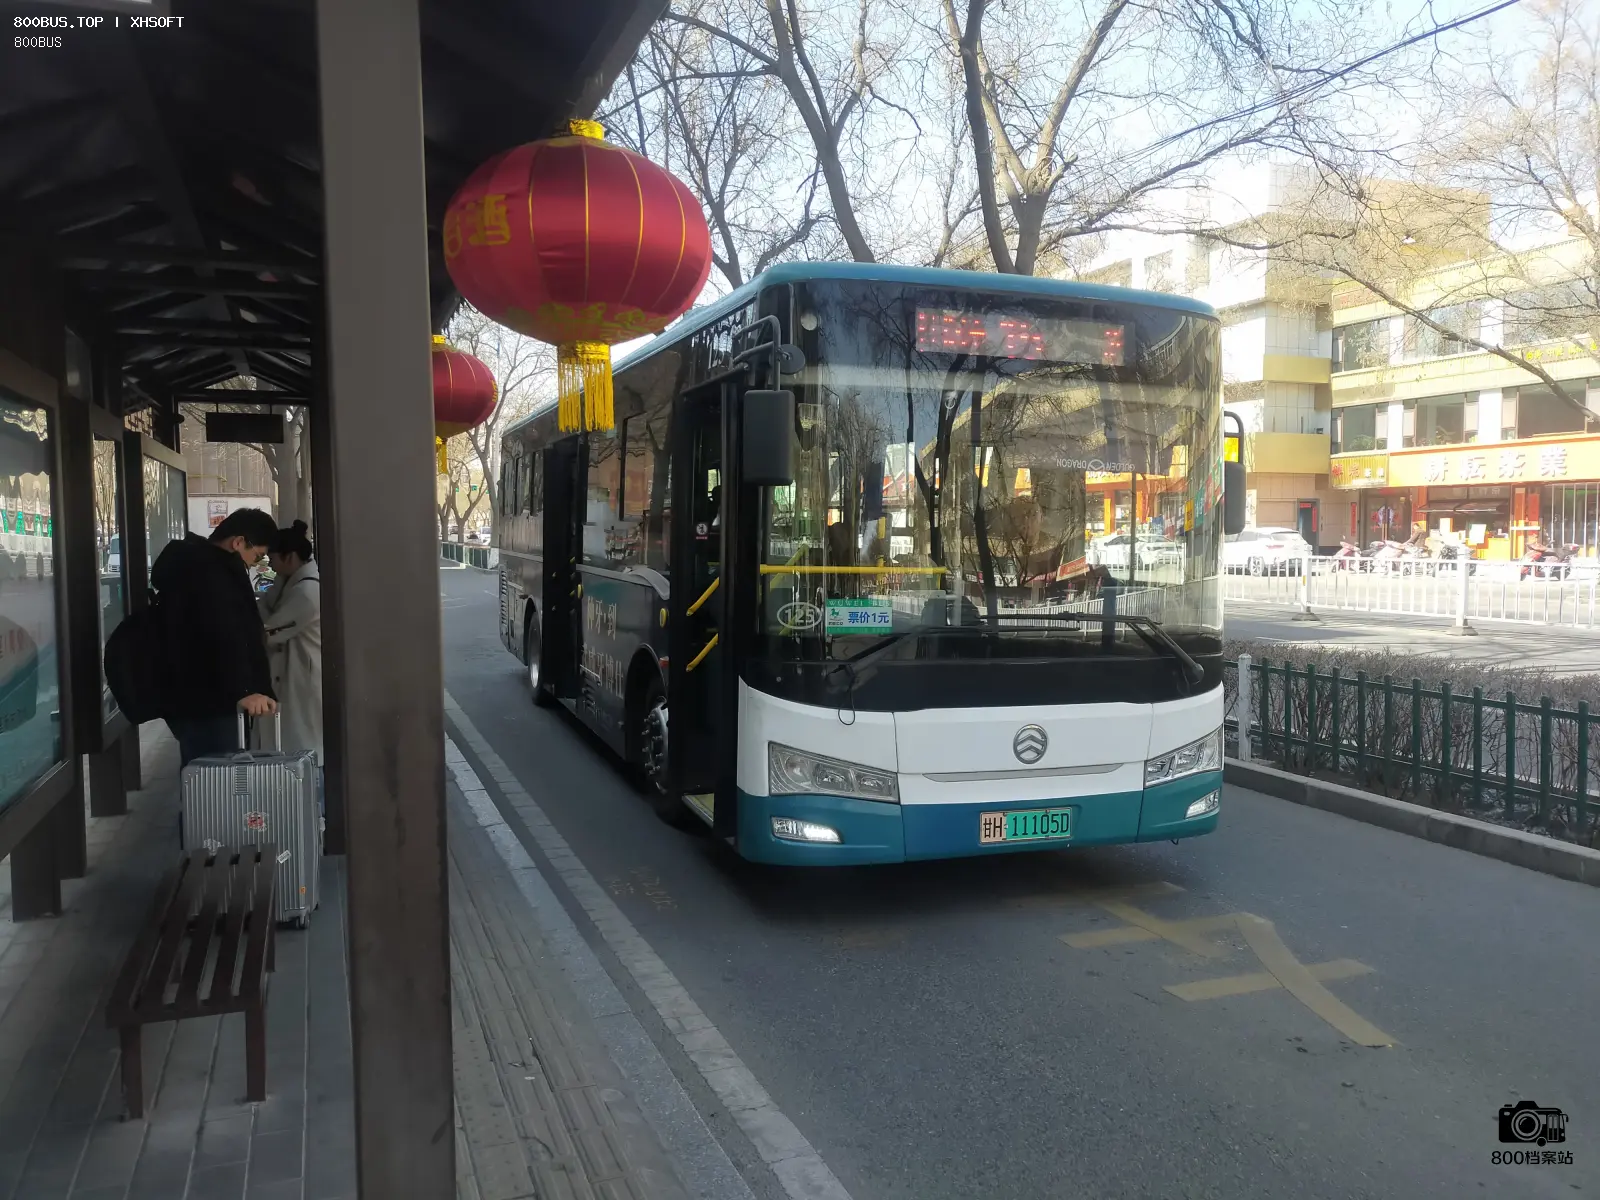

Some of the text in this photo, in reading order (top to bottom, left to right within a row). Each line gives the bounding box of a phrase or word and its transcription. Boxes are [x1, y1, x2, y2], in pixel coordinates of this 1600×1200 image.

[1056, 458, 1135, 472] GOLDEN DRAGON
[828, 599, 864, 607] WUWEI
[785, 608, 815, 624] 125
[847, 611, 890, 624] 票价1元
